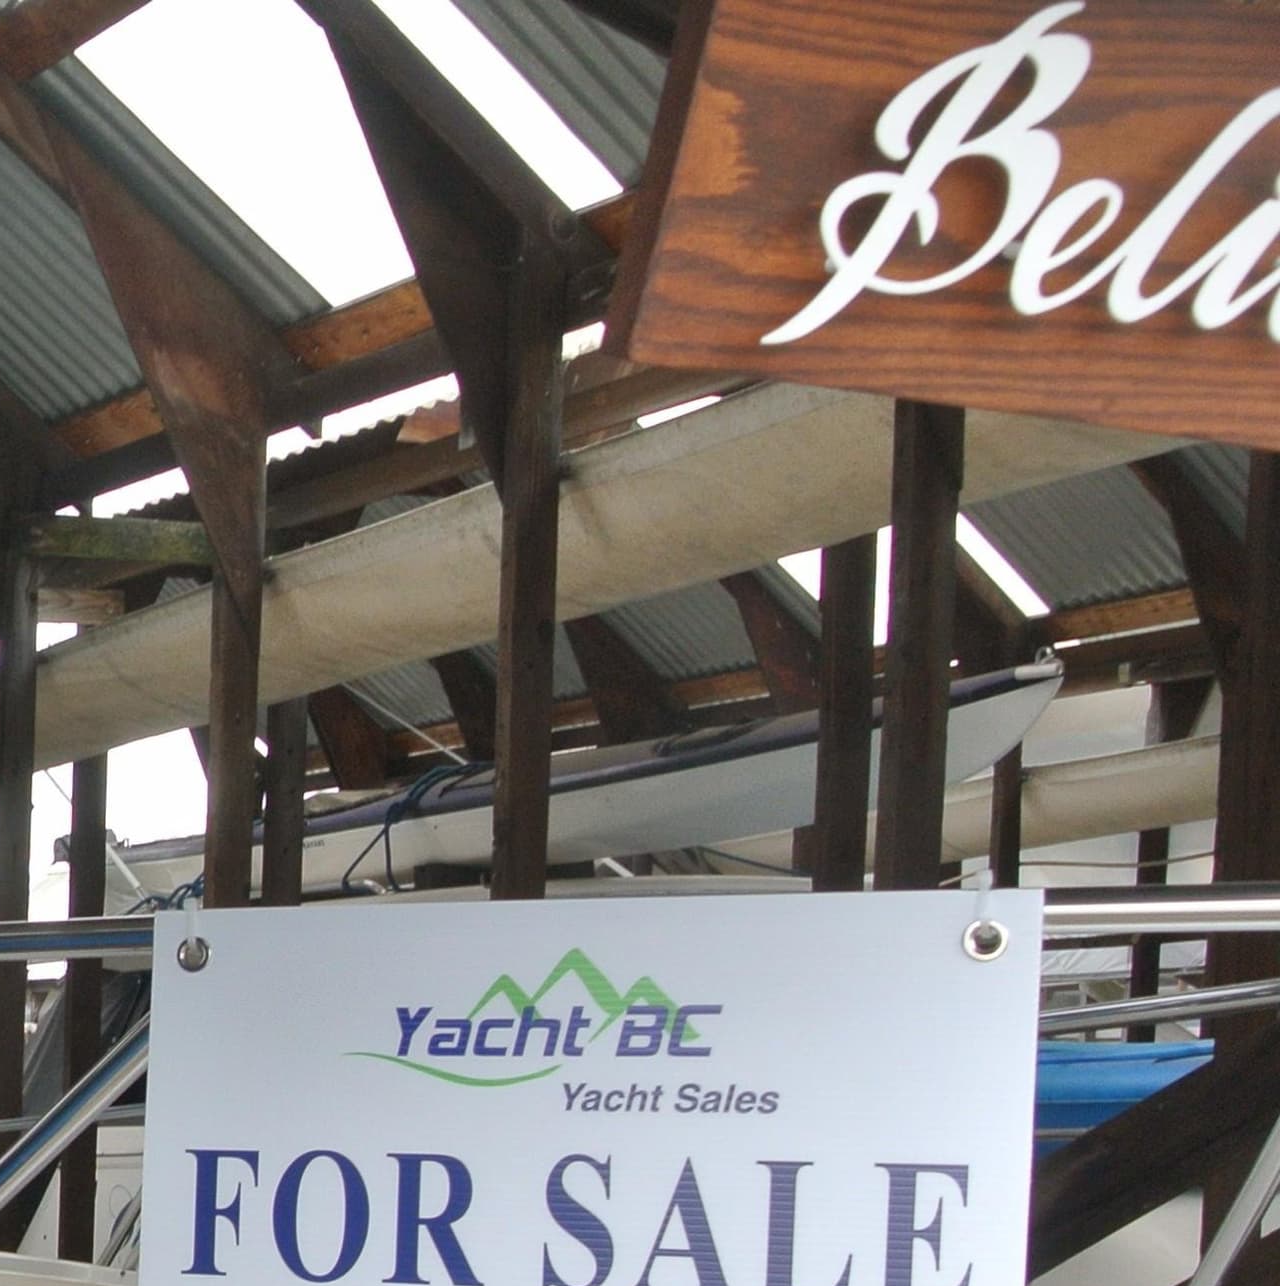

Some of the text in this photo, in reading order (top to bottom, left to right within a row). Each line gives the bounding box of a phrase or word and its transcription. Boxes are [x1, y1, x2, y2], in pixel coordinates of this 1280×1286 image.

[760, 1, 1280, 345] Beli
[394, 1004, 723, 1058] Yacht BC
[562, 1082, 780, 1115] Yacht Sales
